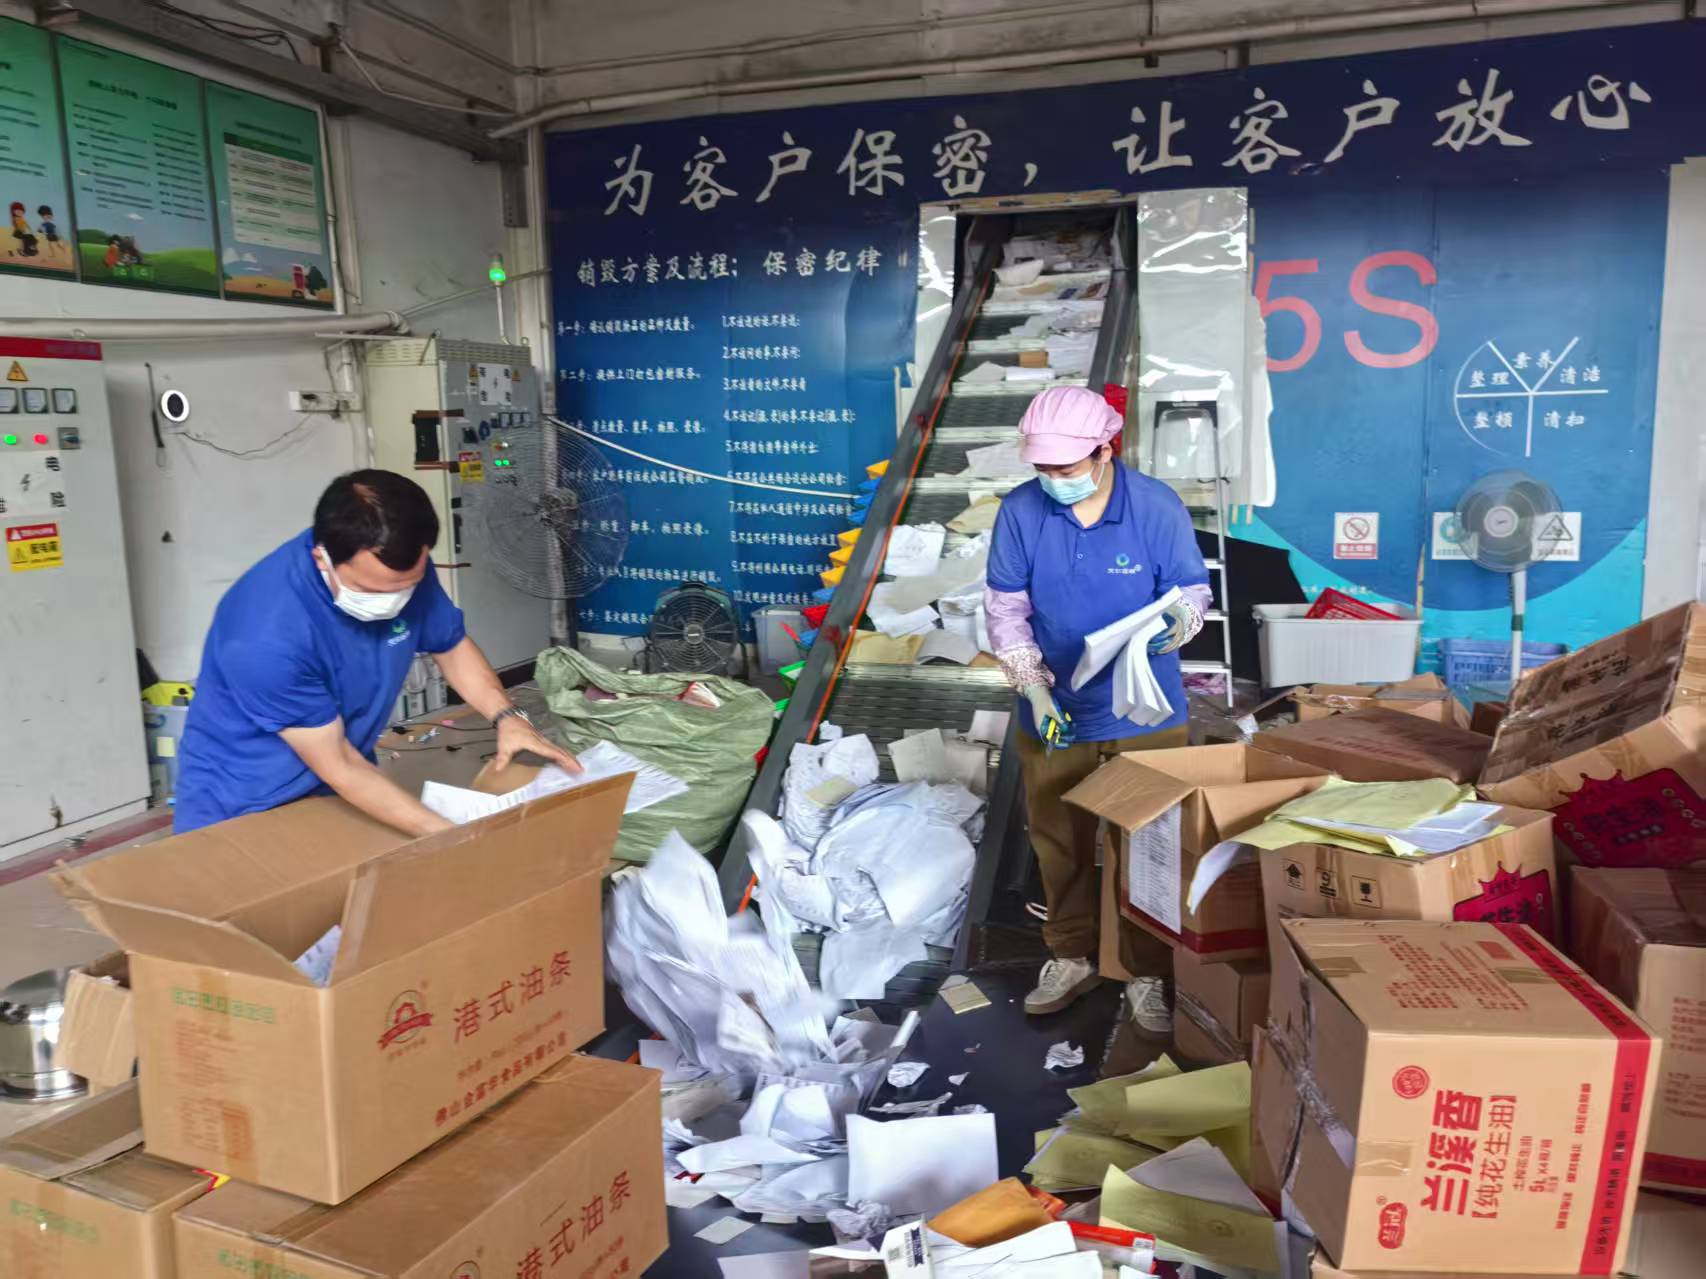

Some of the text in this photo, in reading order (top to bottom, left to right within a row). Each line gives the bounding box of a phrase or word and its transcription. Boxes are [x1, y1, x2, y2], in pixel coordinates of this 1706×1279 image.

[763, 246, 882, 277] 保密纪律
[1254, 250, 1440, 373] 5S
[1512, 349, 1557, 370] 素养
[1560, 365, 1601, 385] 清洁
[1469, 369, 1511, 388] 整理
[1473, 410, 1513, 429] 整顿
[1544, 410, 1585, 429] 清扫
[452, 951, 574, 1043] 港式油条
[1419, 1088, 1485, 1216] 兰溪香
[1471, 1094, 1517, 1220] 【纯花生油】
[515, 1170, 632, 1279] 港式油条
